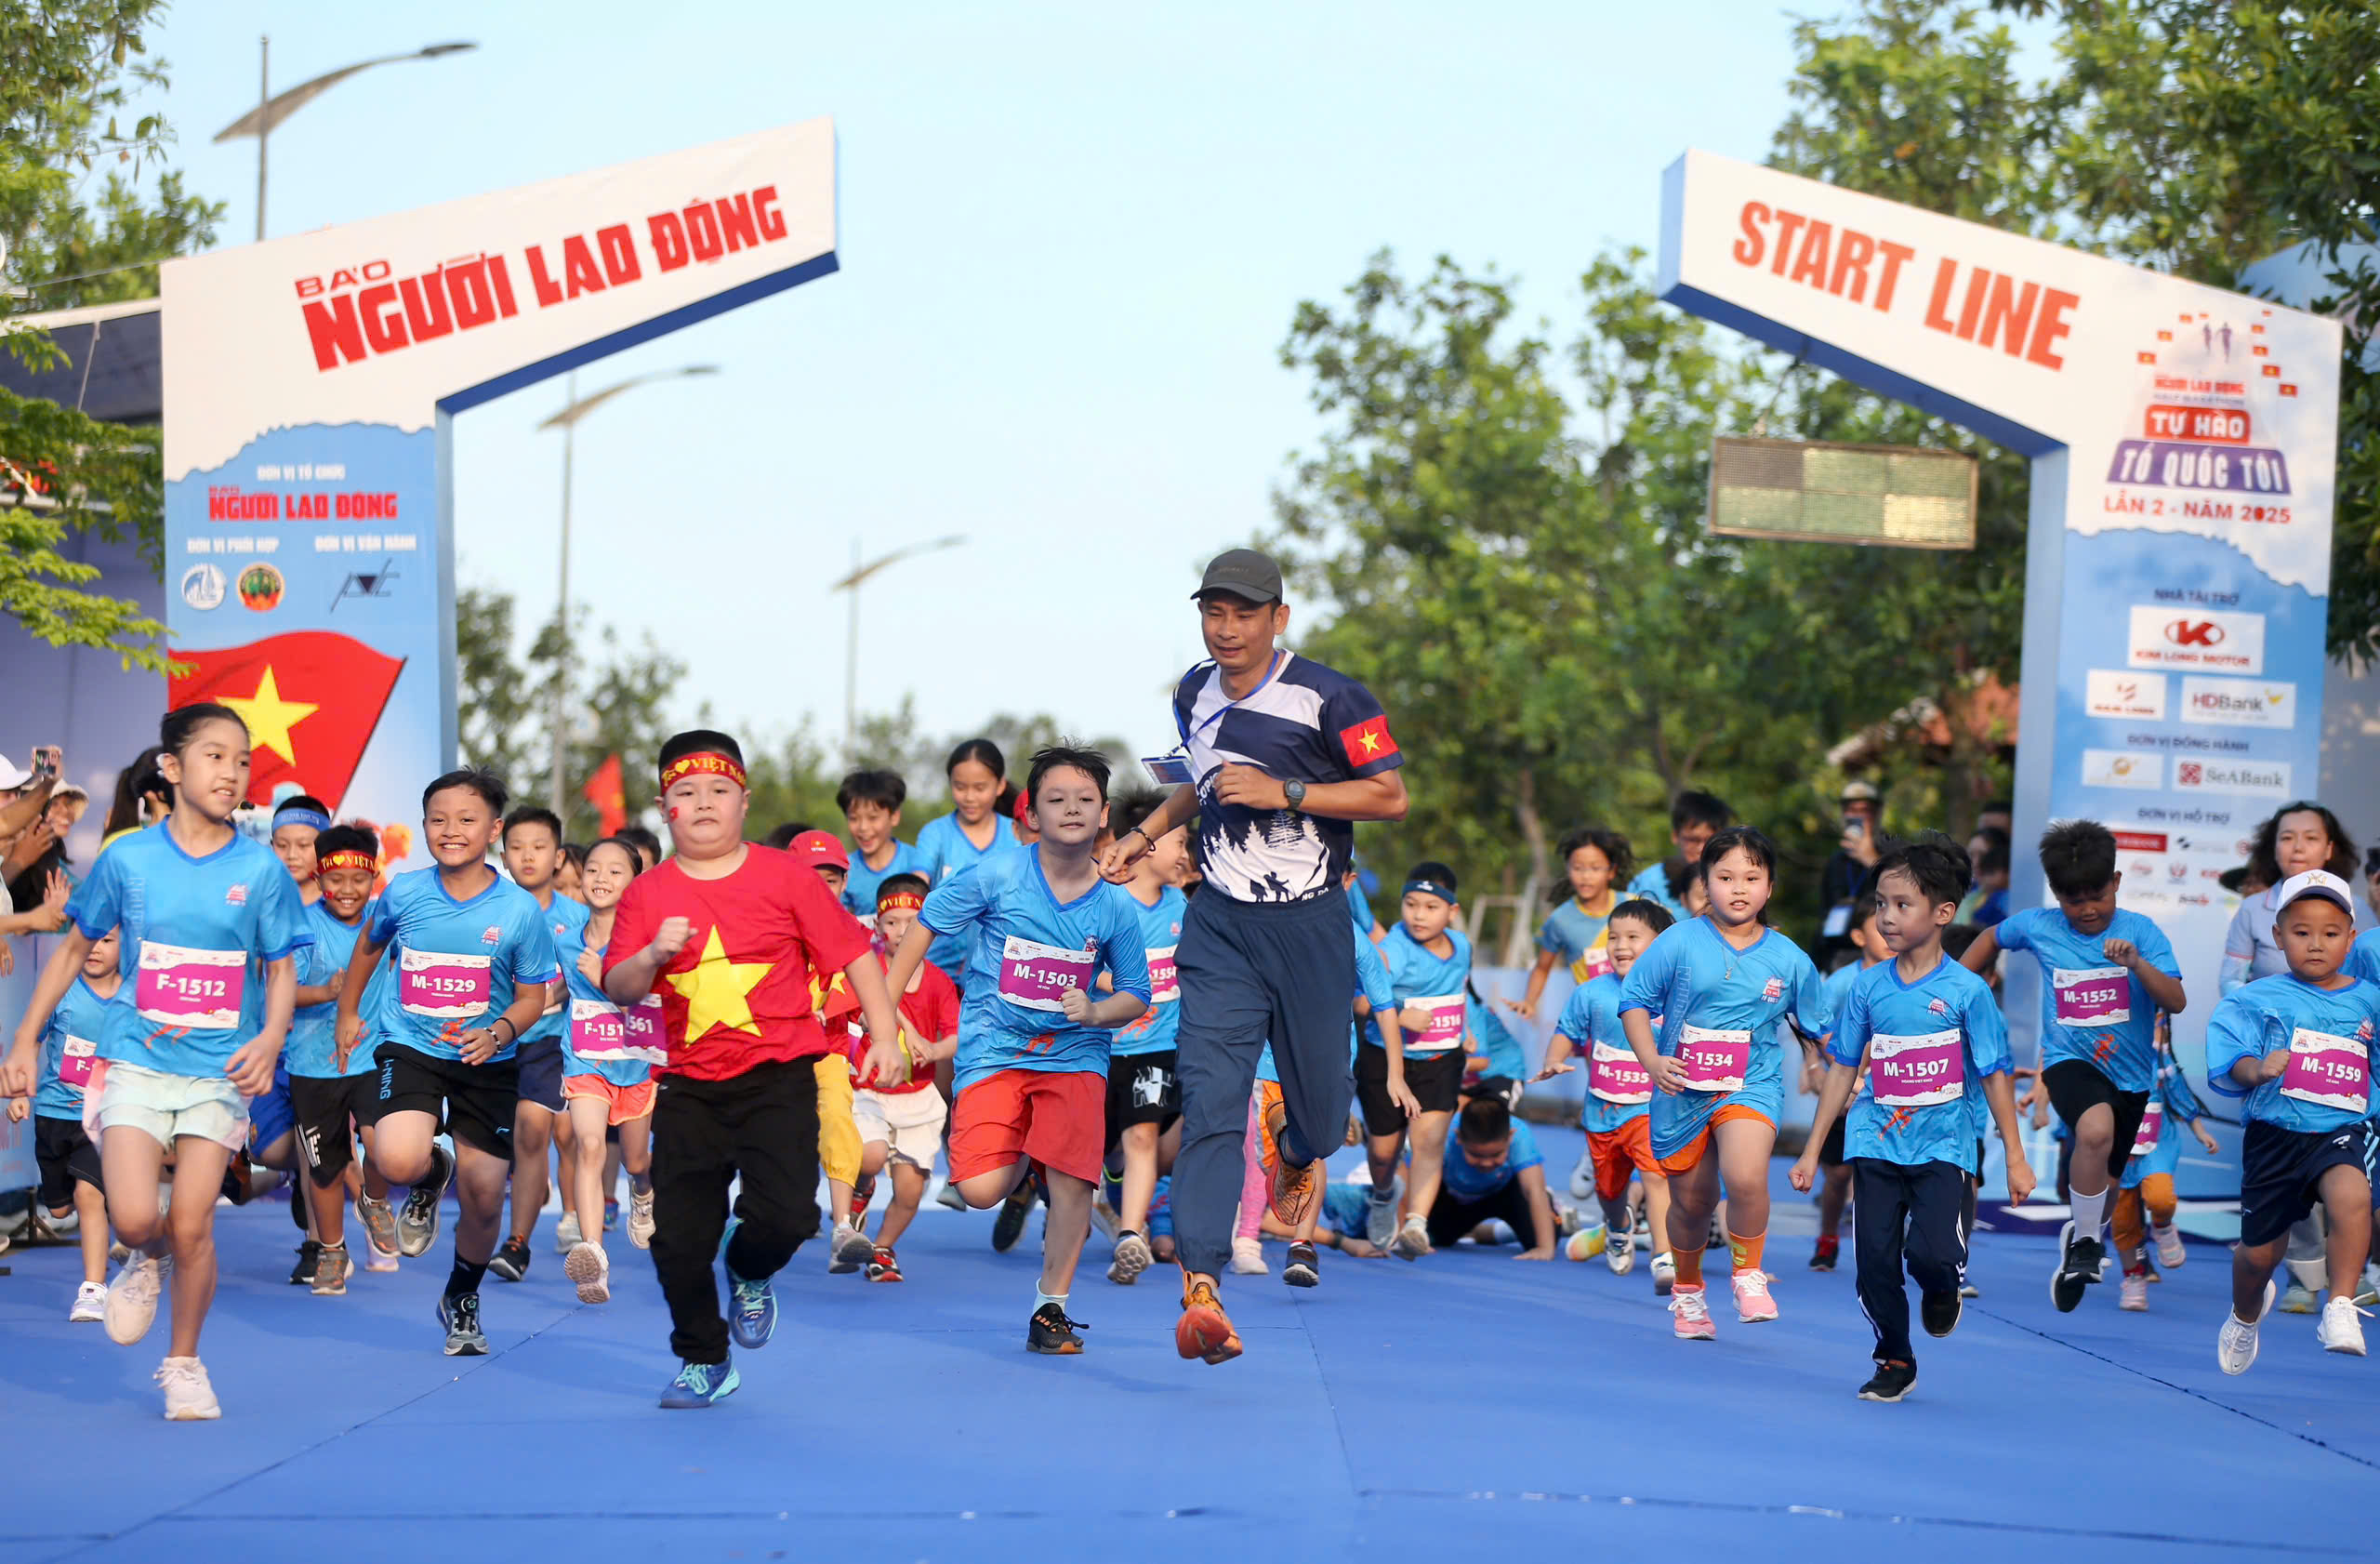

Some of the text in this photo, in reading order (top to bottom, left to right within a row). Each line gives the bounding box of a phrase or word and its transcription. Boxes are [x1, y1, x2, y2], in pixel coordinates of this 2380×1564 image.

[295, 259, 391, 298] BÁO
[301, 185, 787, 372] NGƯỜI LAO ĐỘNG
[1731, 201, 2080, 370] START LINE
[2194, 410, 2244, 439] HÀO
[285, 495, 328, 520] LAO
[2153, 499, 2164, 514] 2
[2241, 507, 2291, 524] 2025
[2193, 693, 2263, 711] HDBank
[691, 756, 728, 773] VIỆT
[2206, 767, 2284, 788] SeABank
[156, 974, 226, 997] F-1512
[411, 974, 477, 993] M-1529
[1013, 963, 1078, 987] M-1503
[2064, 988, 2117, 1003] M-1552
[585, 1022, 624, 1037] F-151
[1682, 1047, 1733, 1067] F-1534
[1884, 1058, 1949, 1077] M-1507
[1598, 1064, 1650, 1083] M-1535
[2301, 1056, 2361, 1082] M-1559
